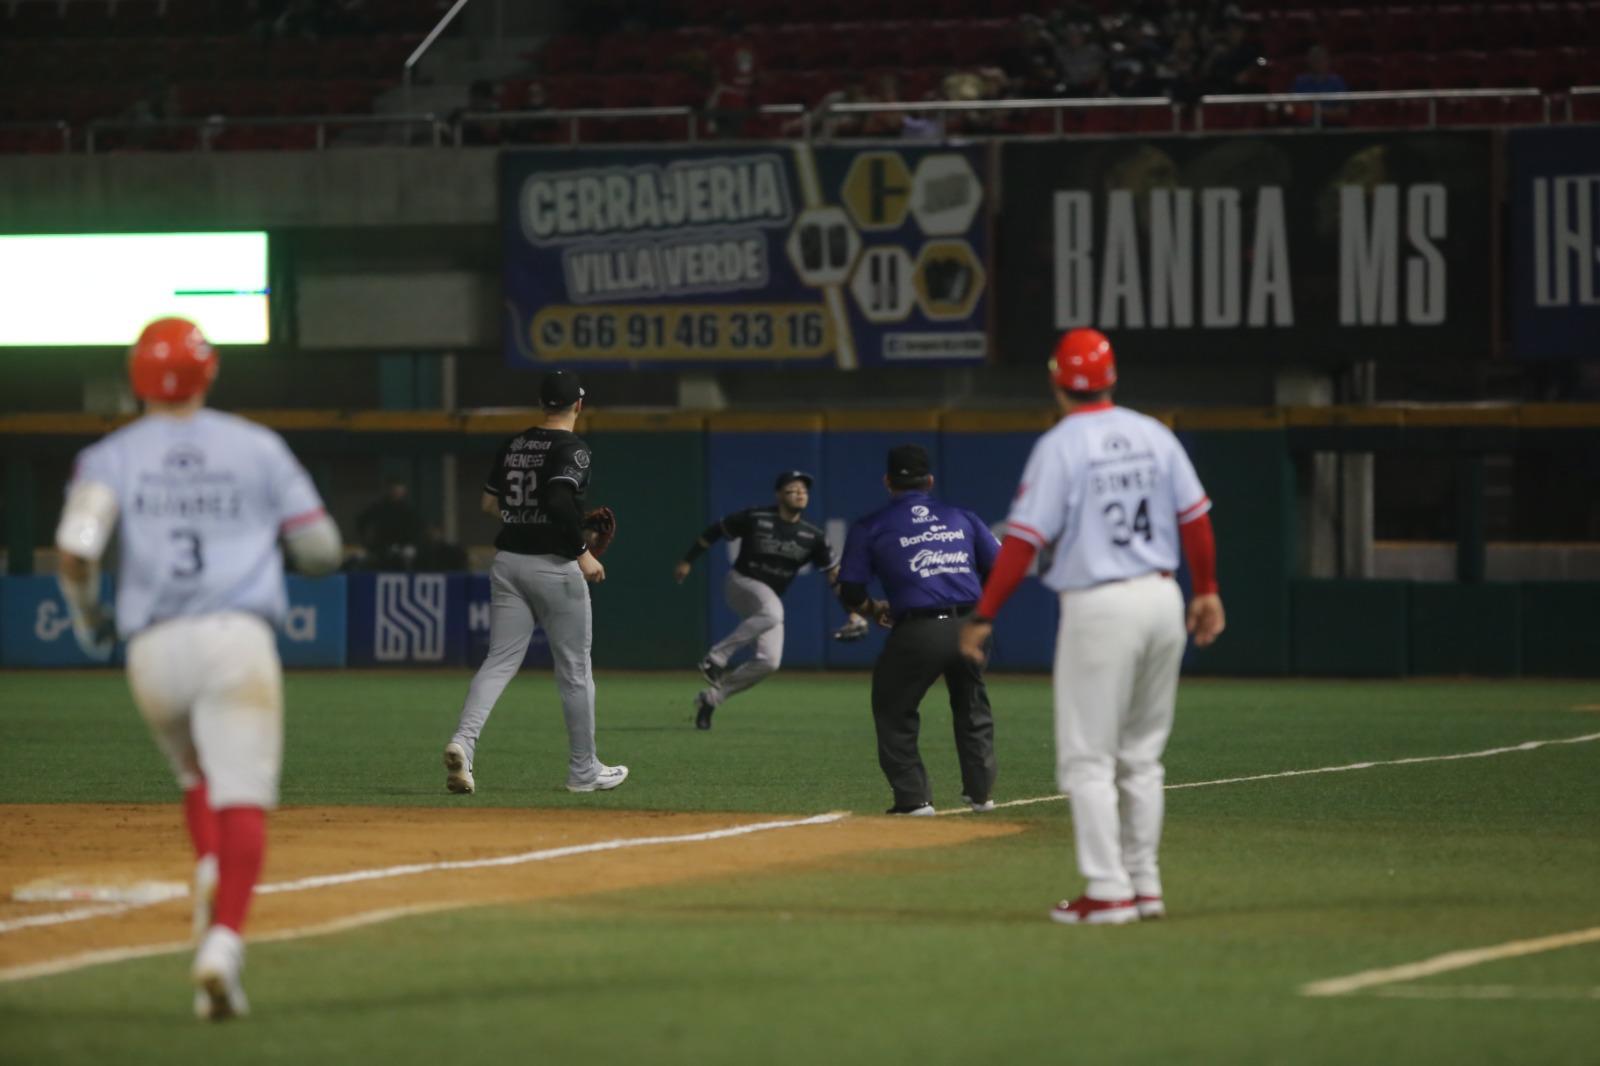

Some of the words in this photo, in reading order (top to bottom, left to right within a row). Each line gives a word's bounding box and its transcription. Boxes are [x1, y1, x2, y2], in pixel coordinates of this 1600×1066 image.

[525, 162, 783, 236] CERRAJERIA
[570, 242, 656, 295] VILLA
[664, 238, 764, 288] VERDE
[1053, 186, 1295, 329] BANDA
[1338, 184, 1447, 326] MS
[572, 312, 615, 349] 66
[626, 312, 665, 348] 91
[675, 311, 719, 347] 46
[729, 310, 773, 346] 33
[786, 310, 824, 345] 16
[506, 470, 538, 506] 32
[899, 529, 965, 547] BanCoppel
[911, 515, 938, 524] MEGA
[1103, 496, 1152, 547] 34
[170, 527, 204, 579] 3
[908, 549, 969, 572] Caliente
